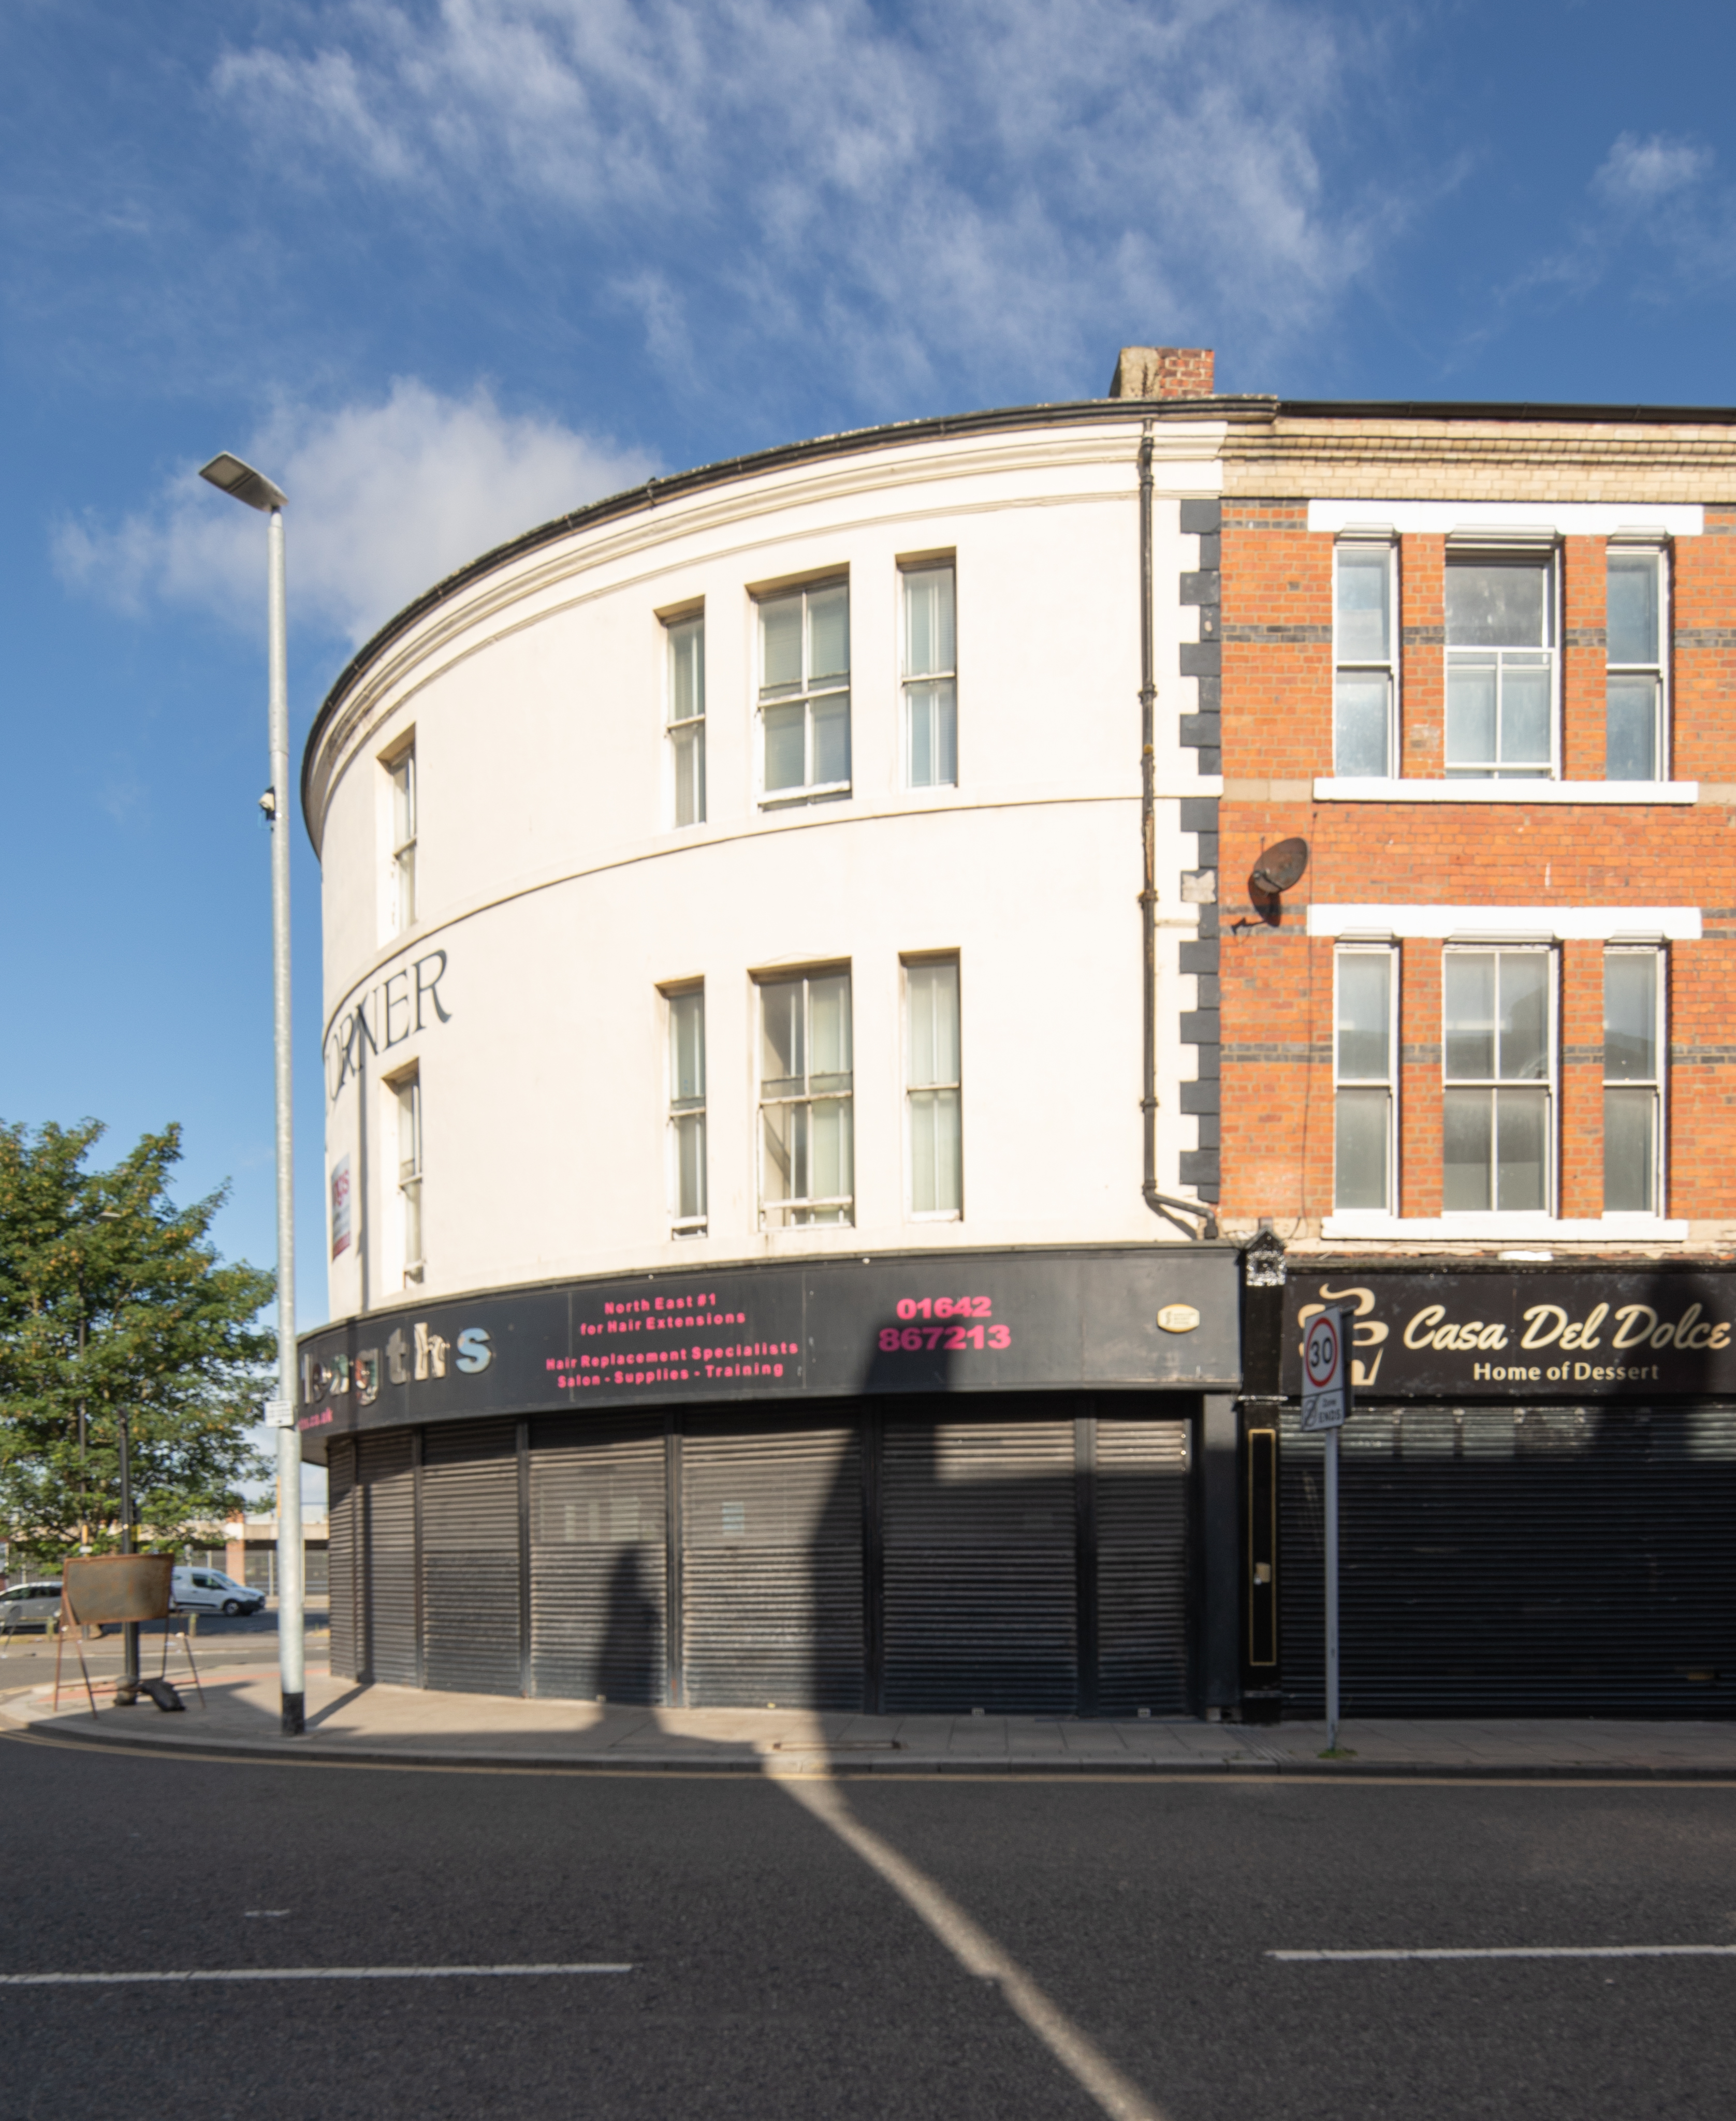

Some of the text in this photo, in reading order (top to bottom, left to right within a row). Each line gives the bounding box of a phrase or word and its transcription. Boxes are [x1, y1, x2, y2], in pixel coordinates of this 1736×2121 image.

[604, 1293, 716, 1315] North East #1
[896, 1296, 992, 1320] 01642
[580, 1312, 746, 1336] for Hair Extensions
[1403, 1302, 1731, 1351] Casa Del Dolce
[879, 1324, 1012, 1352] 867213
[546, 1341, 798, 1370] Hair Replacement Specialists
[1310, 1337, 1333, 1368] 30
[558, 1374, 601, 1388] Salon
[614, 1368, 689, 1385] Supplies
[705, 1362, 784, 1378] Training
[1473, 1361, 1659, 1381] Home of Dessert
